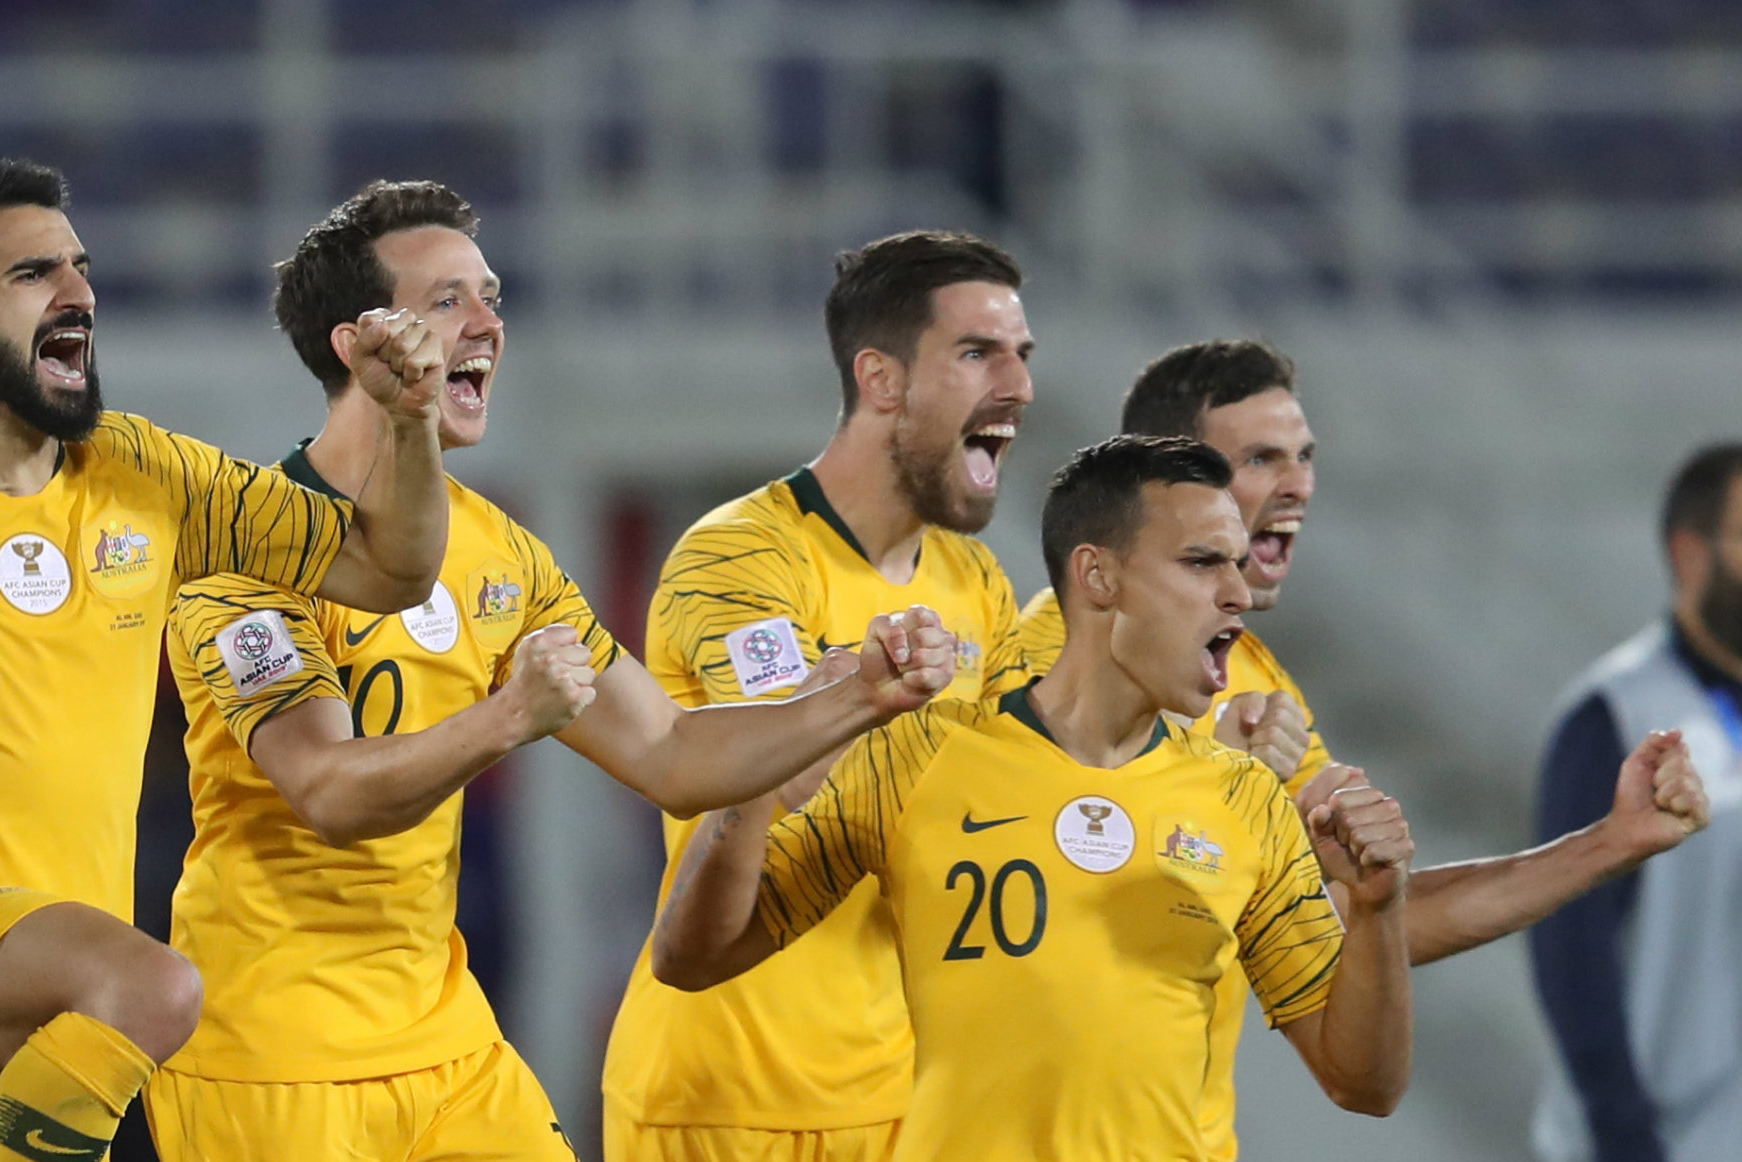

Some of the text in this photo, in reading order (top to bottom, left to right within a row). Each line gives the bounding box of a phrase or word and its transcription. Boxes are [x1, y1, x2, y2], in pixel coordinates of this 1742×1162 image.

[101, 563, 147, 578] AUSTRALIA
[4, 579, 66, 589] AFC ASIAN CUP
[11, 589, 62, 598] CHAMPIONS
[254, 655, 271, 668] AFC
[241, 653, 293, 686] ASIAN CUP
[746, 664, 801, 685] ASIAN CUP
[1069, 846, 1122, 858] CHAMPIONS
[944, 860, 1046, 961] 20
